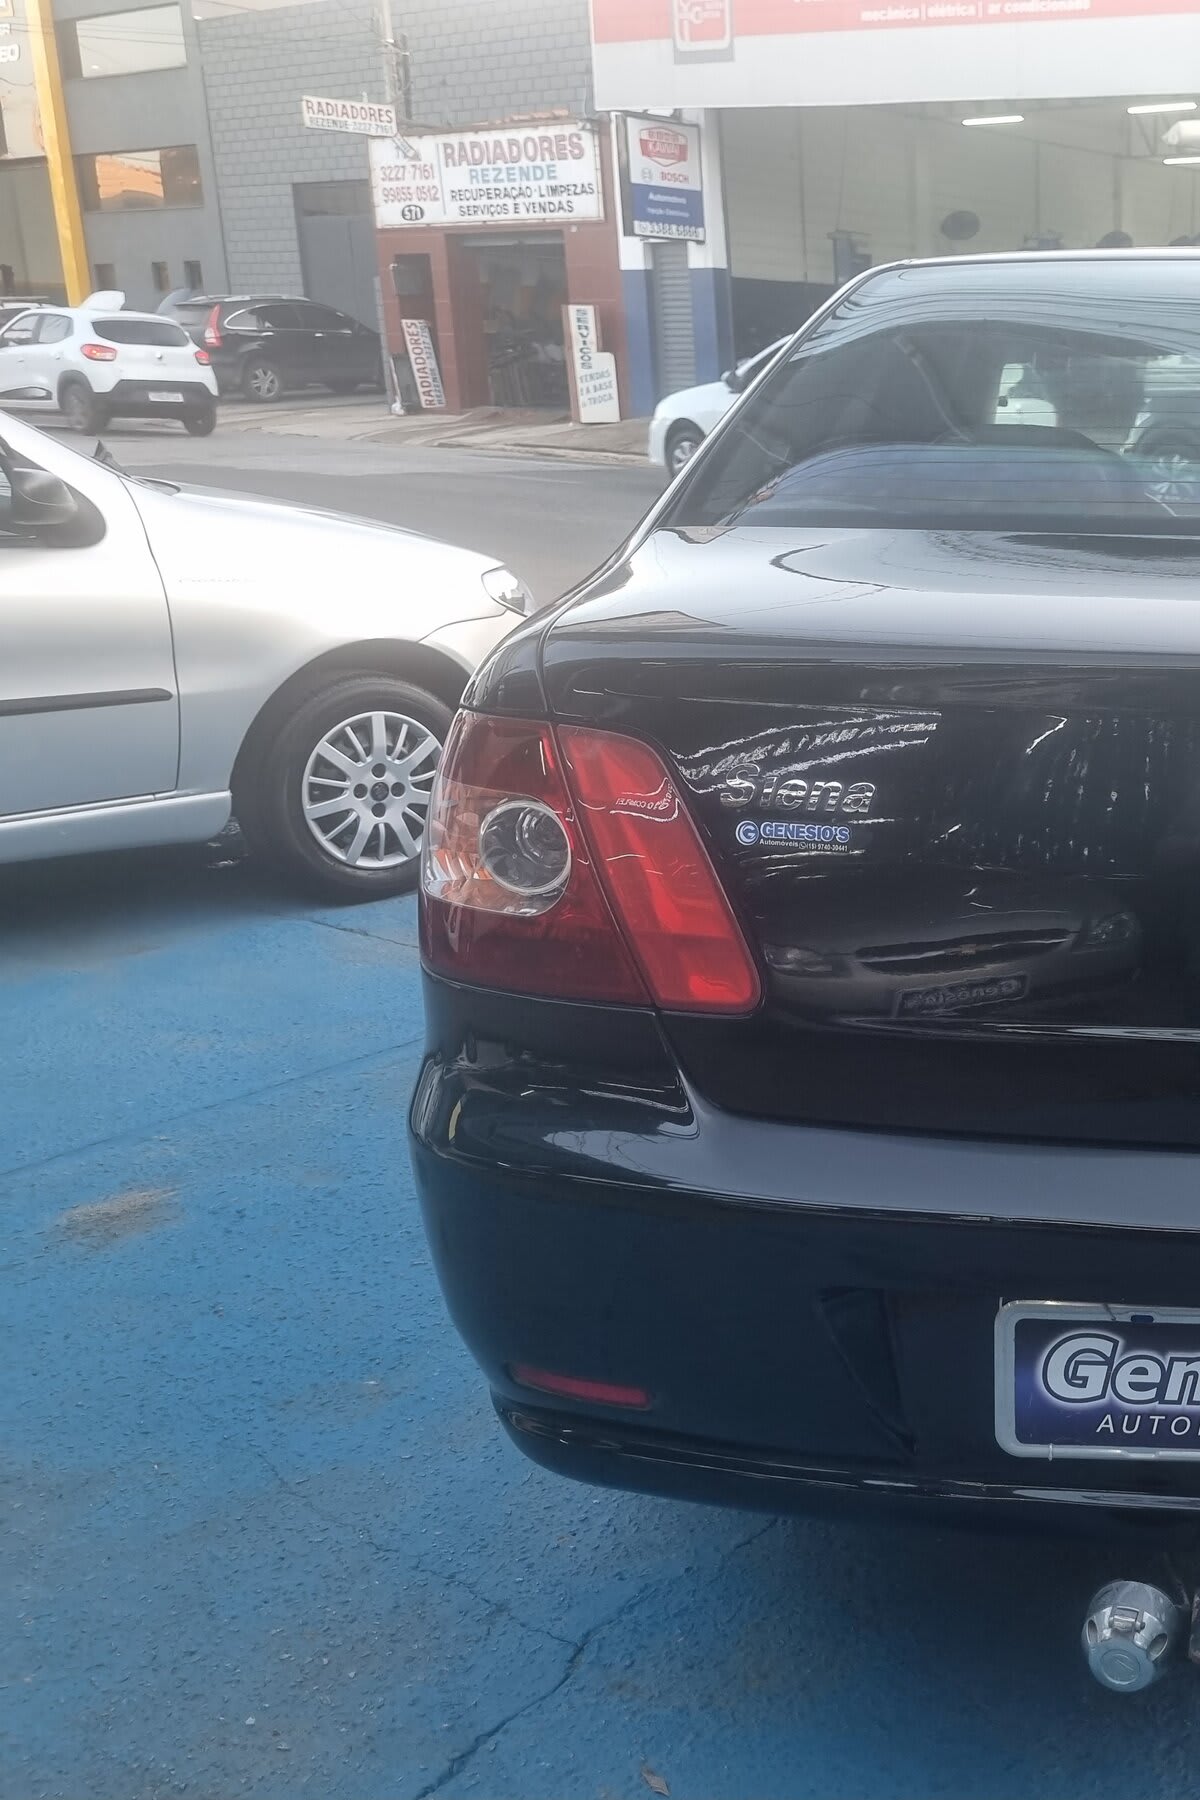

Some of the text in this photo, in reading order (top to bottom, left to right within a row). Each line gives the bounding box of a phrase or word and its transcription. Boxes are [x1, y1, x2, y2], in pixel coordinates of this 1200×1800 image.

[305, 100, 393, 123] RADIADORES
[443, 133, 585, 168] RADIADORES
[470, 164, 558, 184] REZENDE
[661, 171, 689, 184] BOSCH
[538, 182, 595, 198] LIMPEZAS
[459, 200, 574, 217] SERVIÇOS E VENDAS
[405, 321, 436, 407] RADIADORES
[720, 763, 876, 812] Siena
[760, 822, 850, 843] GENESIO'S
[760, 839, 799, 848] Automóveis
